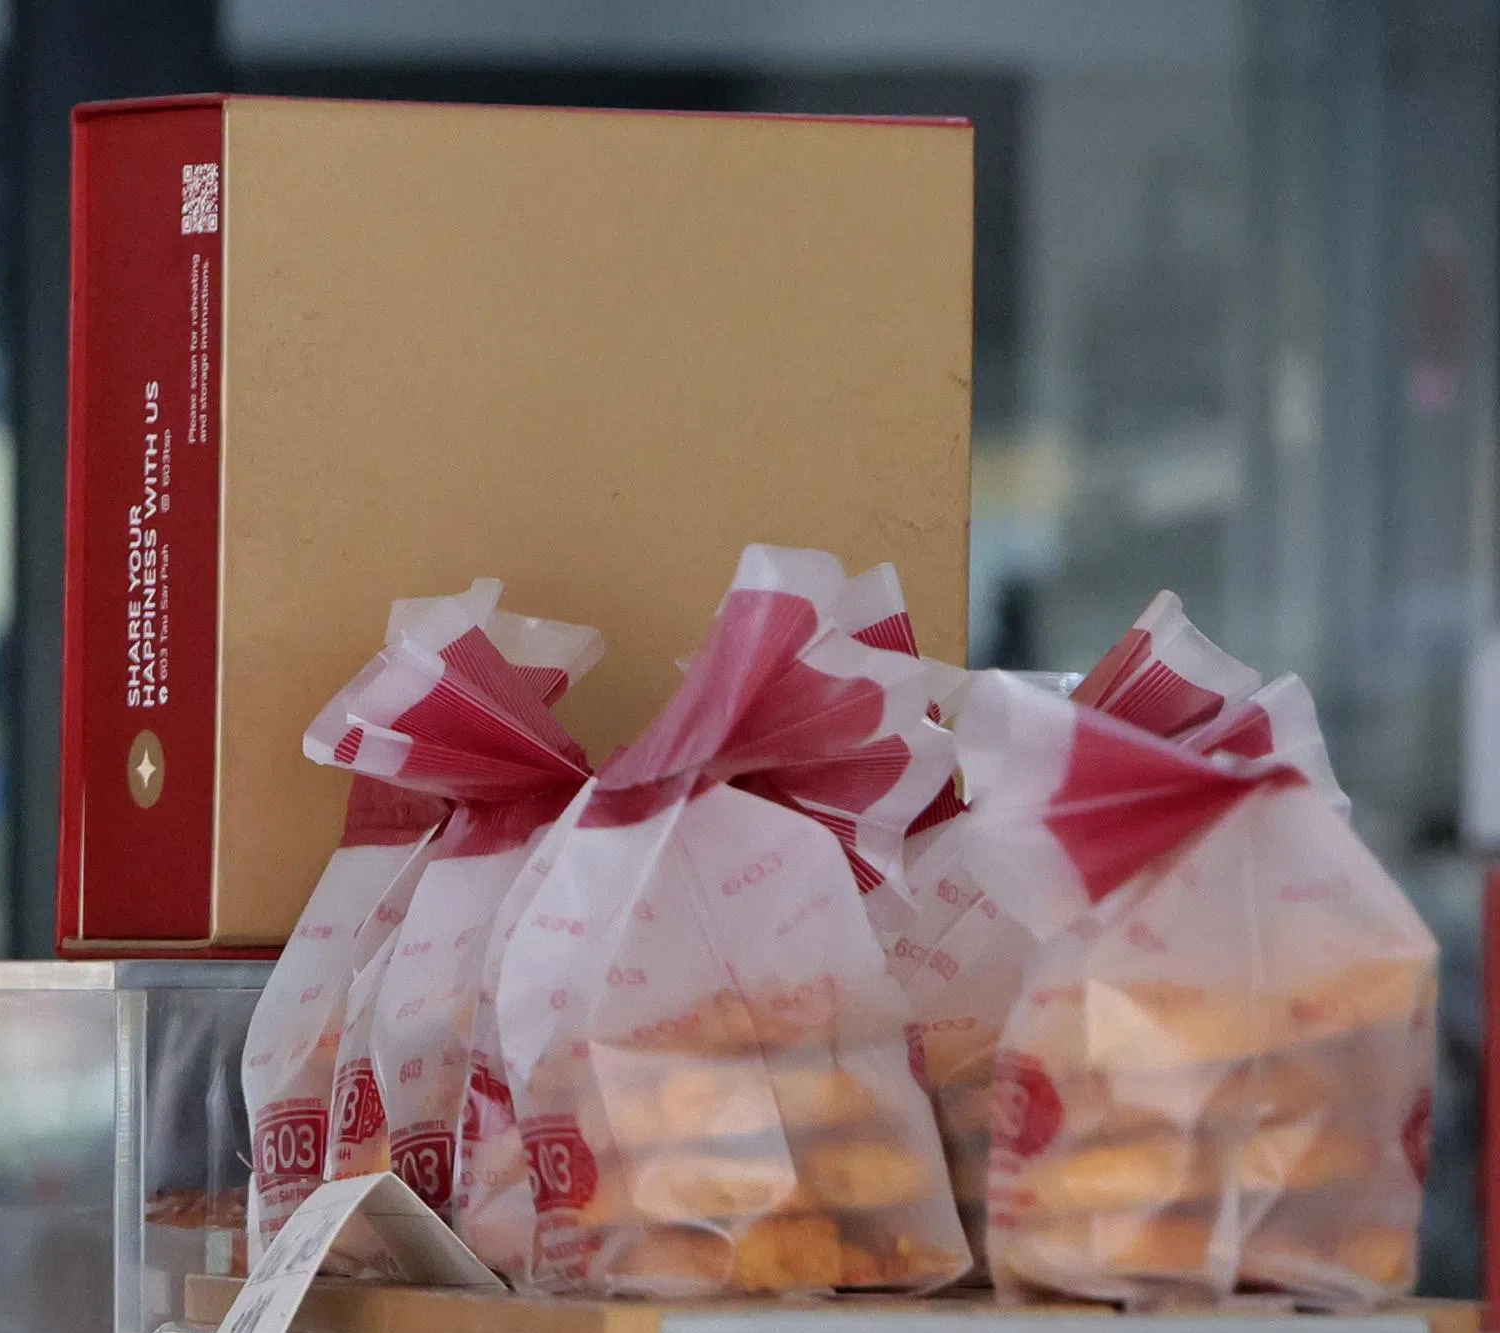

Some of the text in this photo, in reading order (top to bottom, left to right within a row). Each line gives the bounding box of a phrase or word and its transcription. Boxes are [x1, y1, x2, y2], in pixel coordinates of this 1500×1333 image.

[187, 254, 201, 443] Please scan for reheating
[199, 352, 210, 411] storage
[198, 414, 208, 443] and
[142, 381, 159, 707] HAPPINESS WITH US
[127, 505, 142, 707] SHARE YOUR
[159, 584, 170, 611] Sar
[159, 614, 170, 643] Tau
[159, 647, 170, 681] 603
[399, 1058, 424, 1084] 603
[262, 1124, 316, 1174] 603
[392, 1148, 440, 1196] 03
[279, 1190, 297, 1204] SAR
